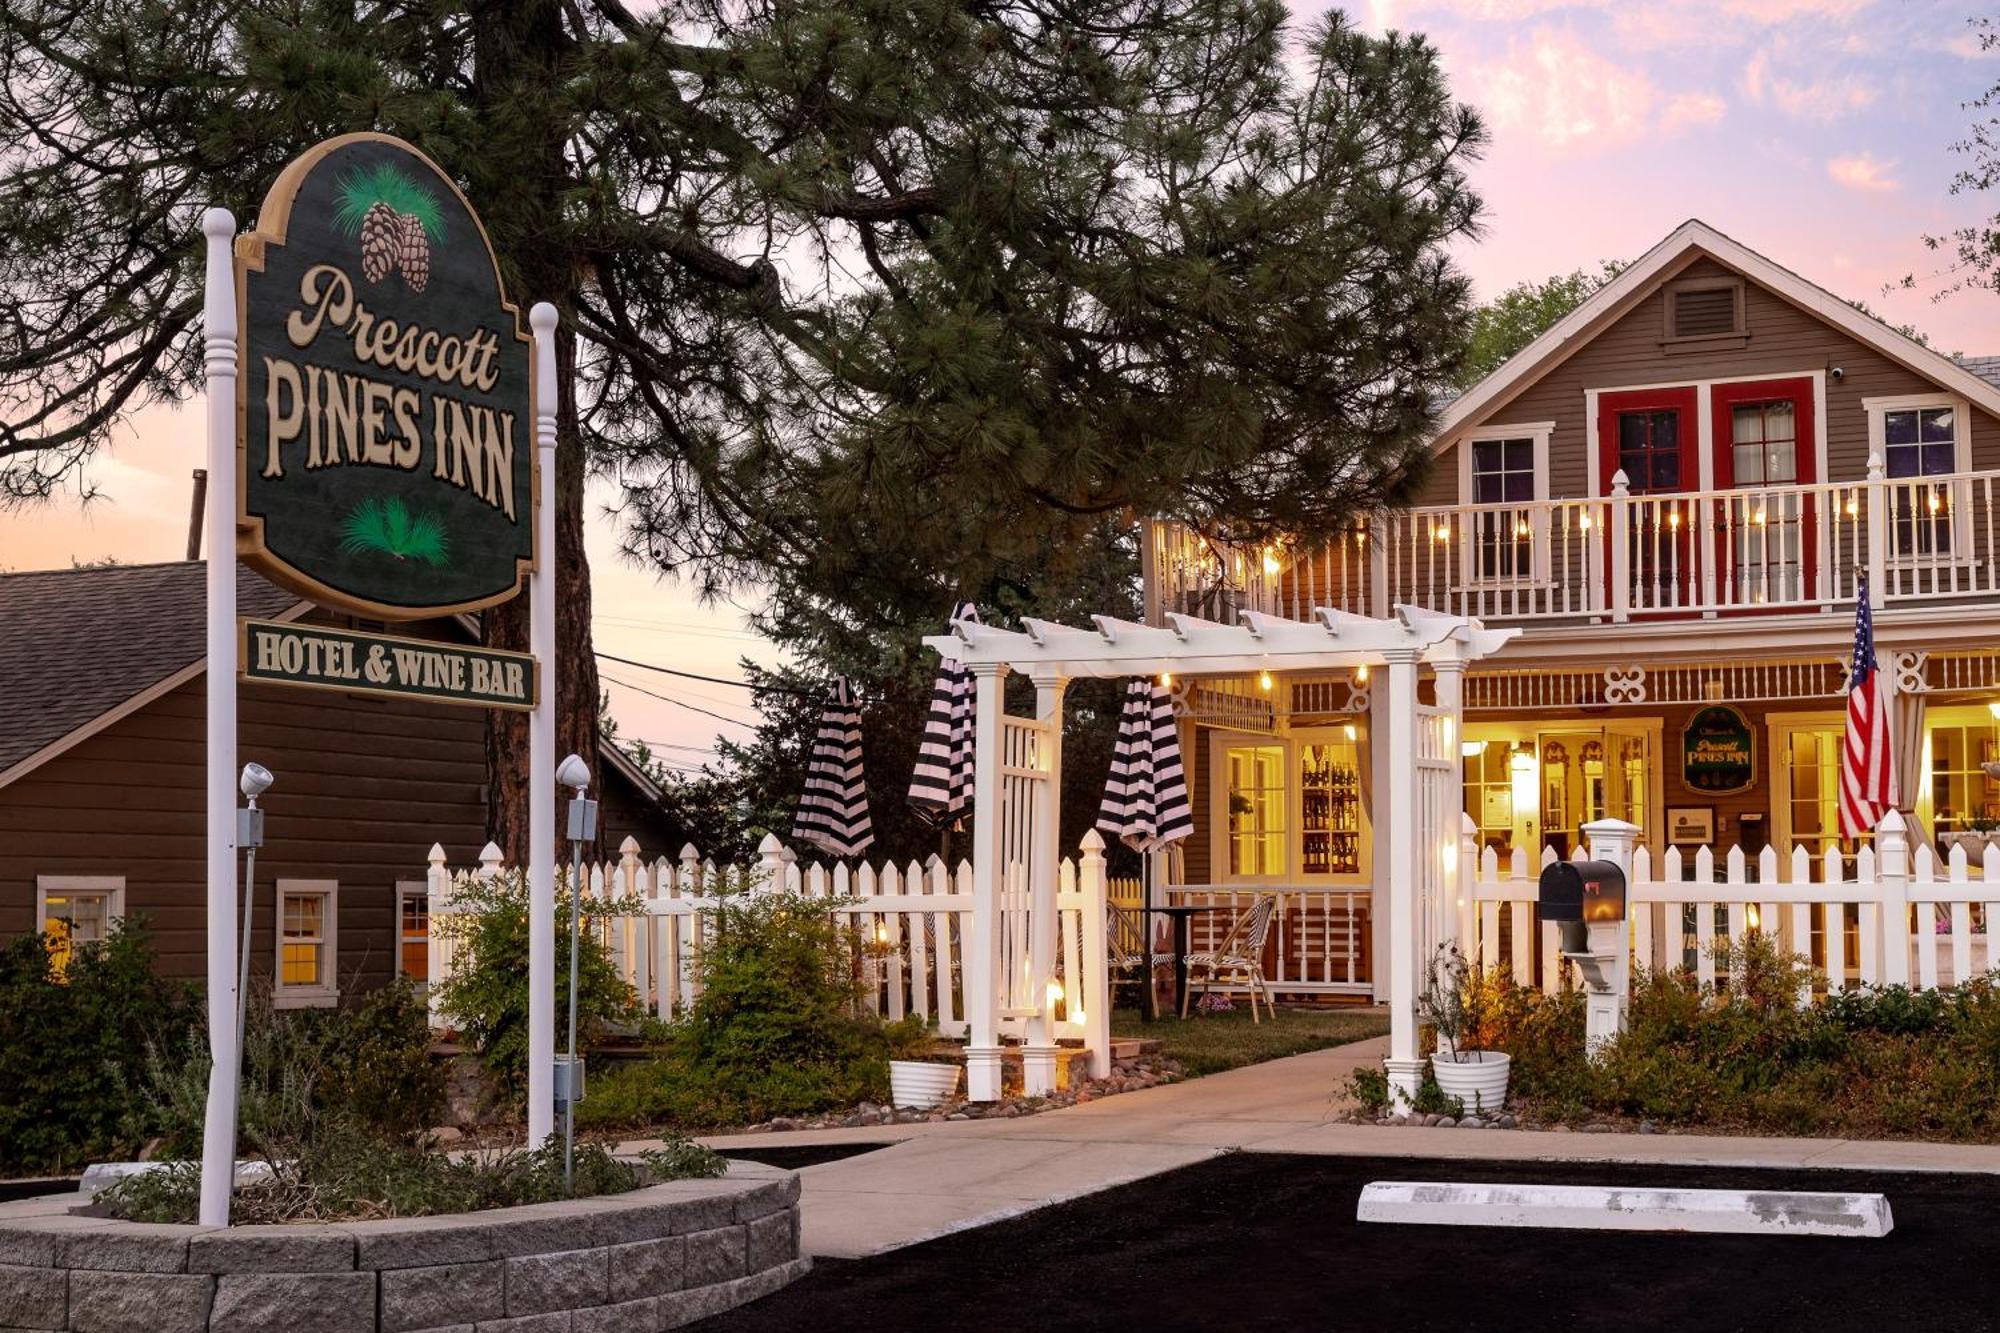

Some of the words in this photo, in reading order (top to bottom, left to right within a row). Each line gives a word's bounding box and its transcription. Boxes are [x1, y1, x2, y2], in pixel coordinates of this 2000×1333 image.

[287, 264, 499, 392] Prescott
[262, 356, 421, 479] PINES
[433, 396, 516, 523] INN
[256, 632, 359, 679] HOTEL
[364, 644, 392, 684] &
[392, 648, 466, 690] WINE
[470, 657, 525, 699] BAR
[1688, 752, 1725, 765] PINES
[1727, 752, 1748, 765] INN
